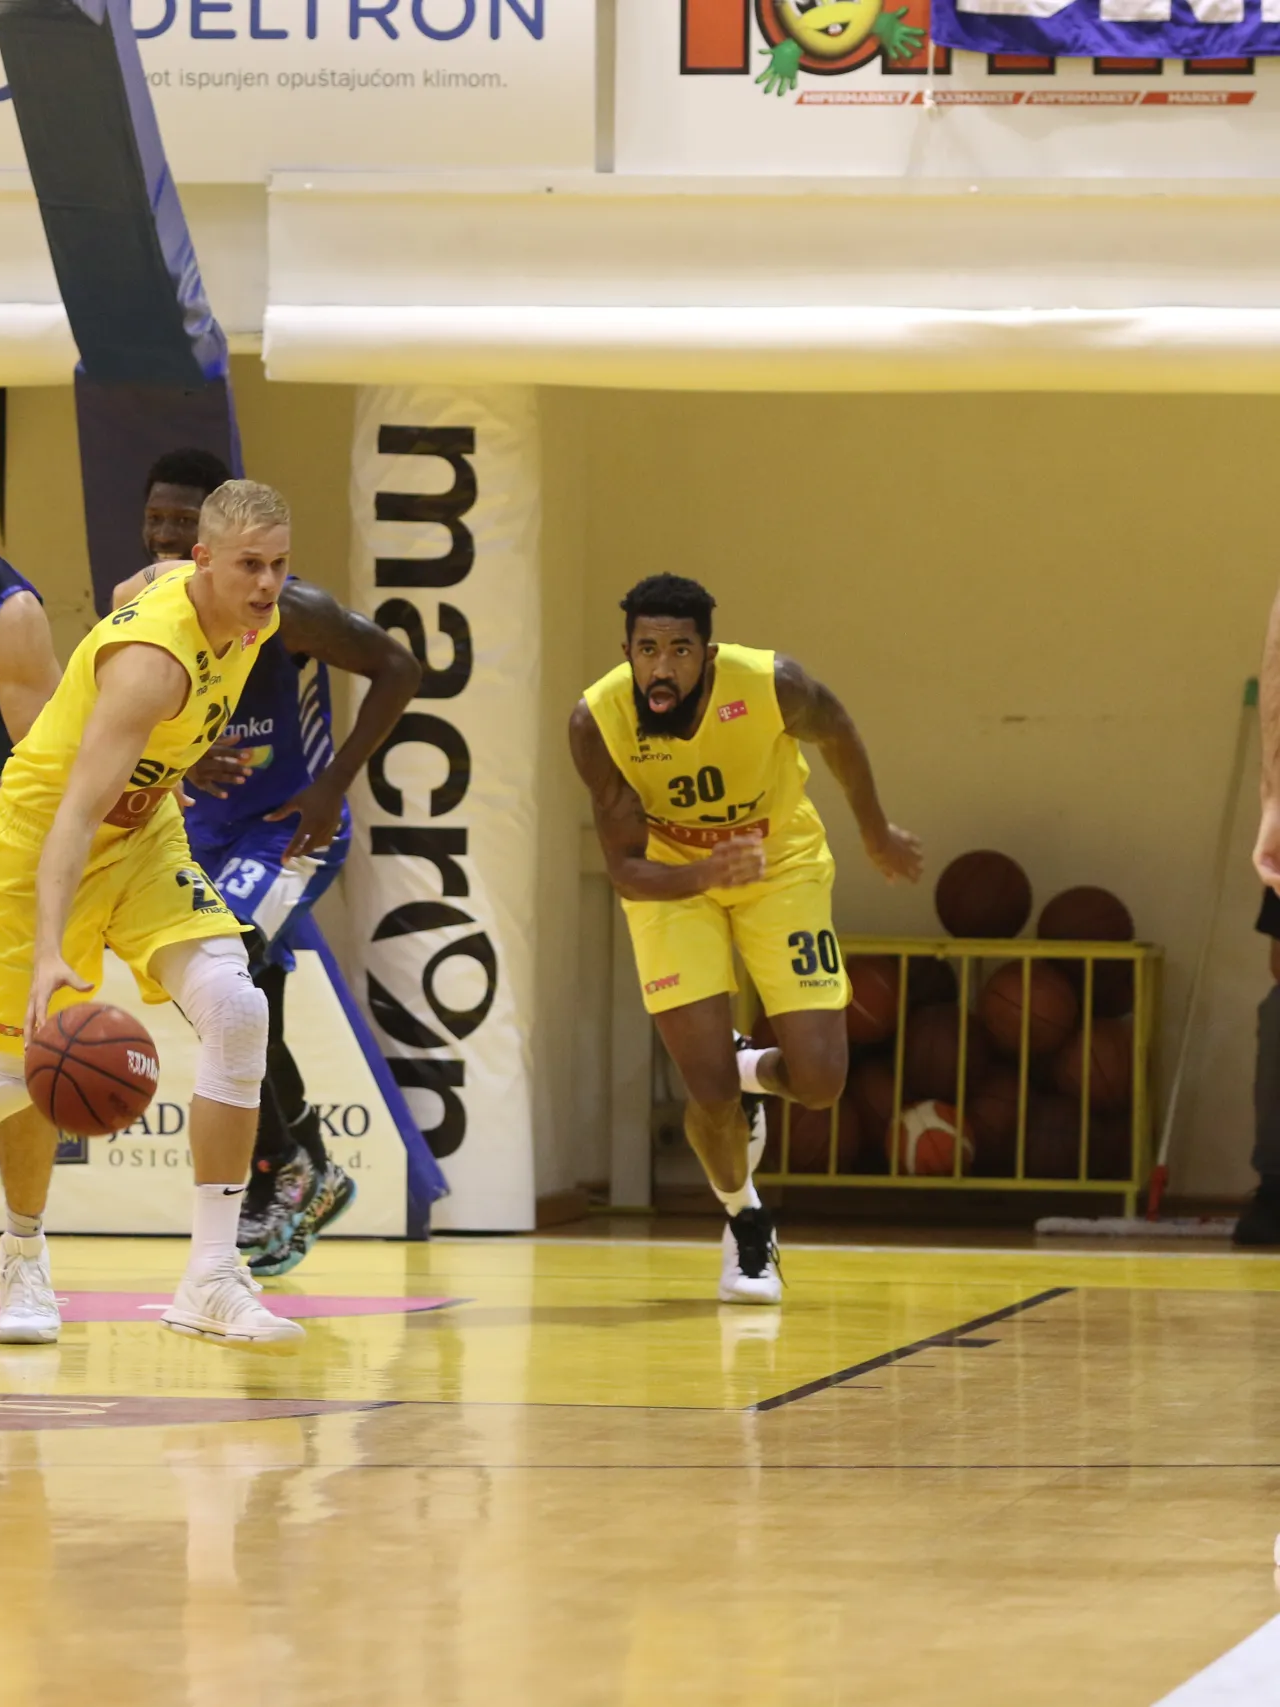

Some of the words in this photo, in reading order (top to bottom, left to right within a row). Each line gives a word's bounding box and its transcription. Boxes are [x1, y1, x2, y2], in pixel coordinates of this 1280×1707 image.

[180, 68, 269, 91] ispunjen
[276, 67, 416, 92] opuštajućom
[423, 68, 508, 88] klimom.
[668, 765, 726, 808] 30
[788, 929, 839, 976] 30
